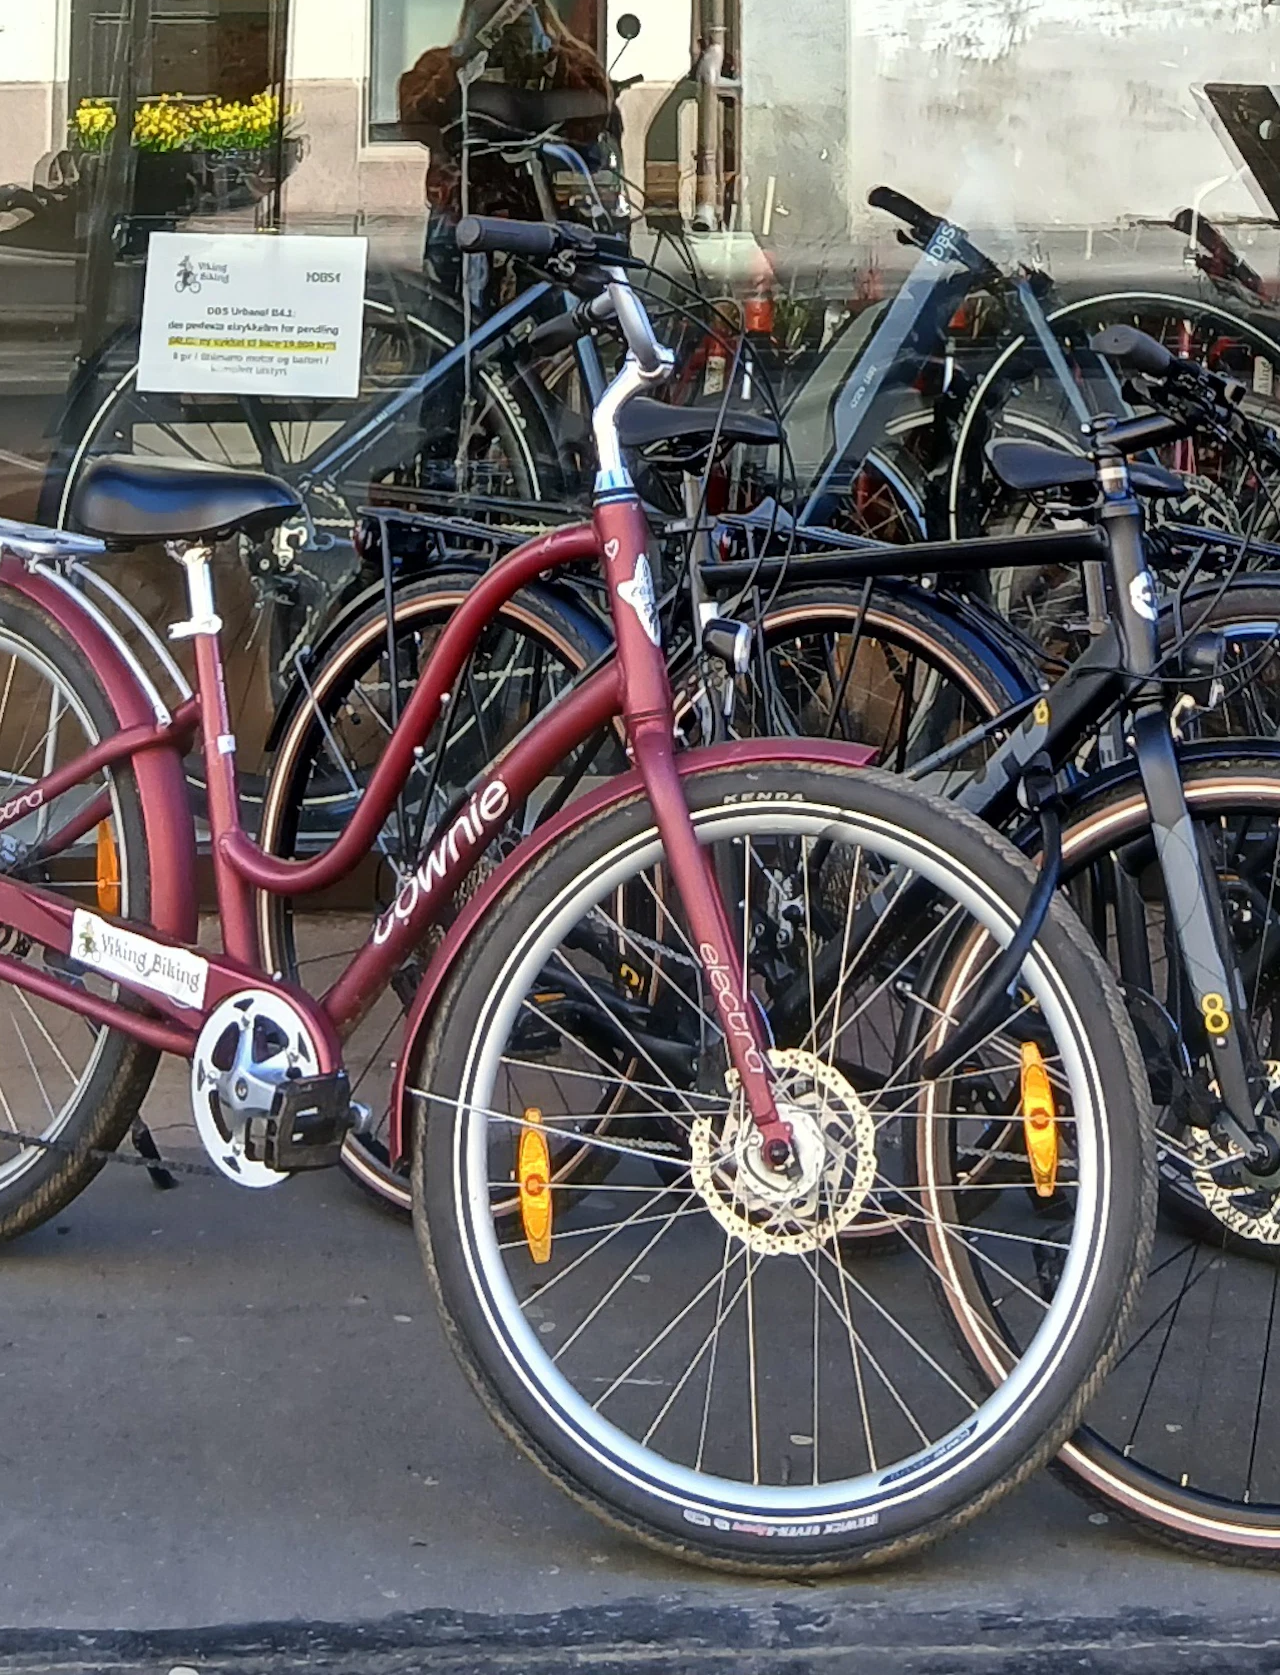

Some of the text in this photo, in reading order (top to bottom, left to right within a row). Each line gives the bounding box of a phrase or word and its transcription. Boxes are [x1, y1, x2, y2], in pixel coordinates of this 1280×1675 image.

[723, 791, 805, 805] KENDA
[101, 932, 200, 993] Viking Biking
[699, 942, 764, 1075] electra
